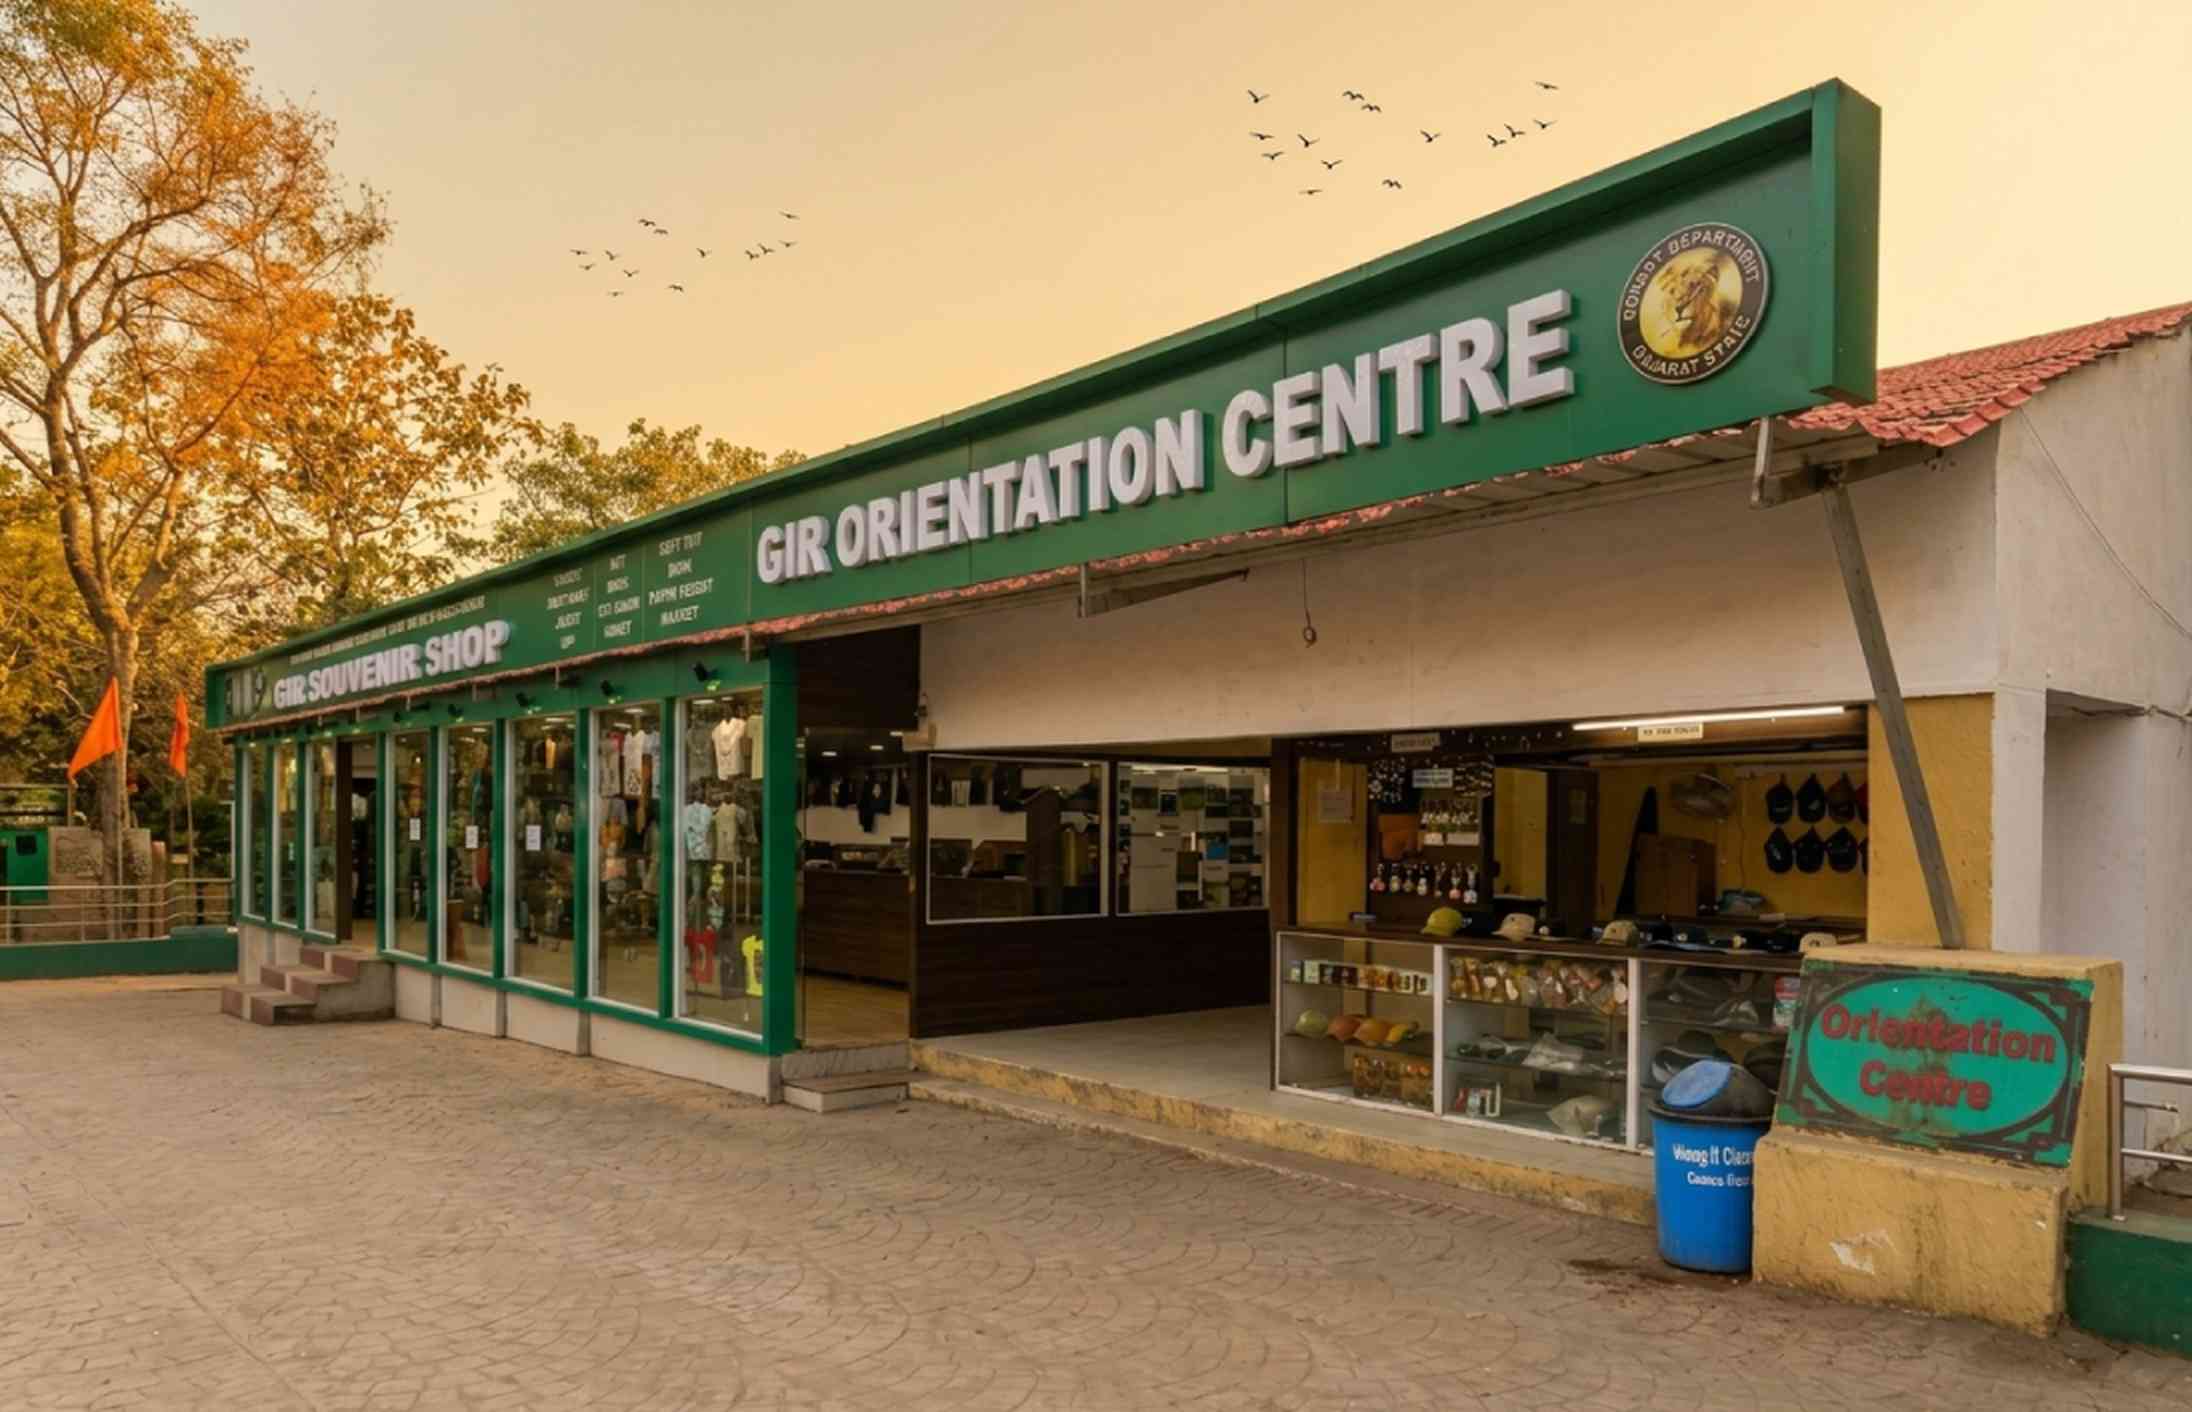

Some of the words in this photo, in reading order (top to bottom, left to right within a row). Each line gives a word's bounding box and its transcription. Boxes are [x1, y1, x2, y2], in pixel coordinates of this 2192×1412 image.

[756, 515, 831, 584] GIR
[836, 408, 1204, 568] ORIENTATION
[1222, 289, 1574, 478] CENTRE
[274, 674, 307, 709] GIR
[308, 643, 423, 701] SOUVENIR
[425, 620, 510, 677] SHOP
[1819, 1002, 2057, 1064] Orientation
[1860, 1060, 1992, 1111] Centre
